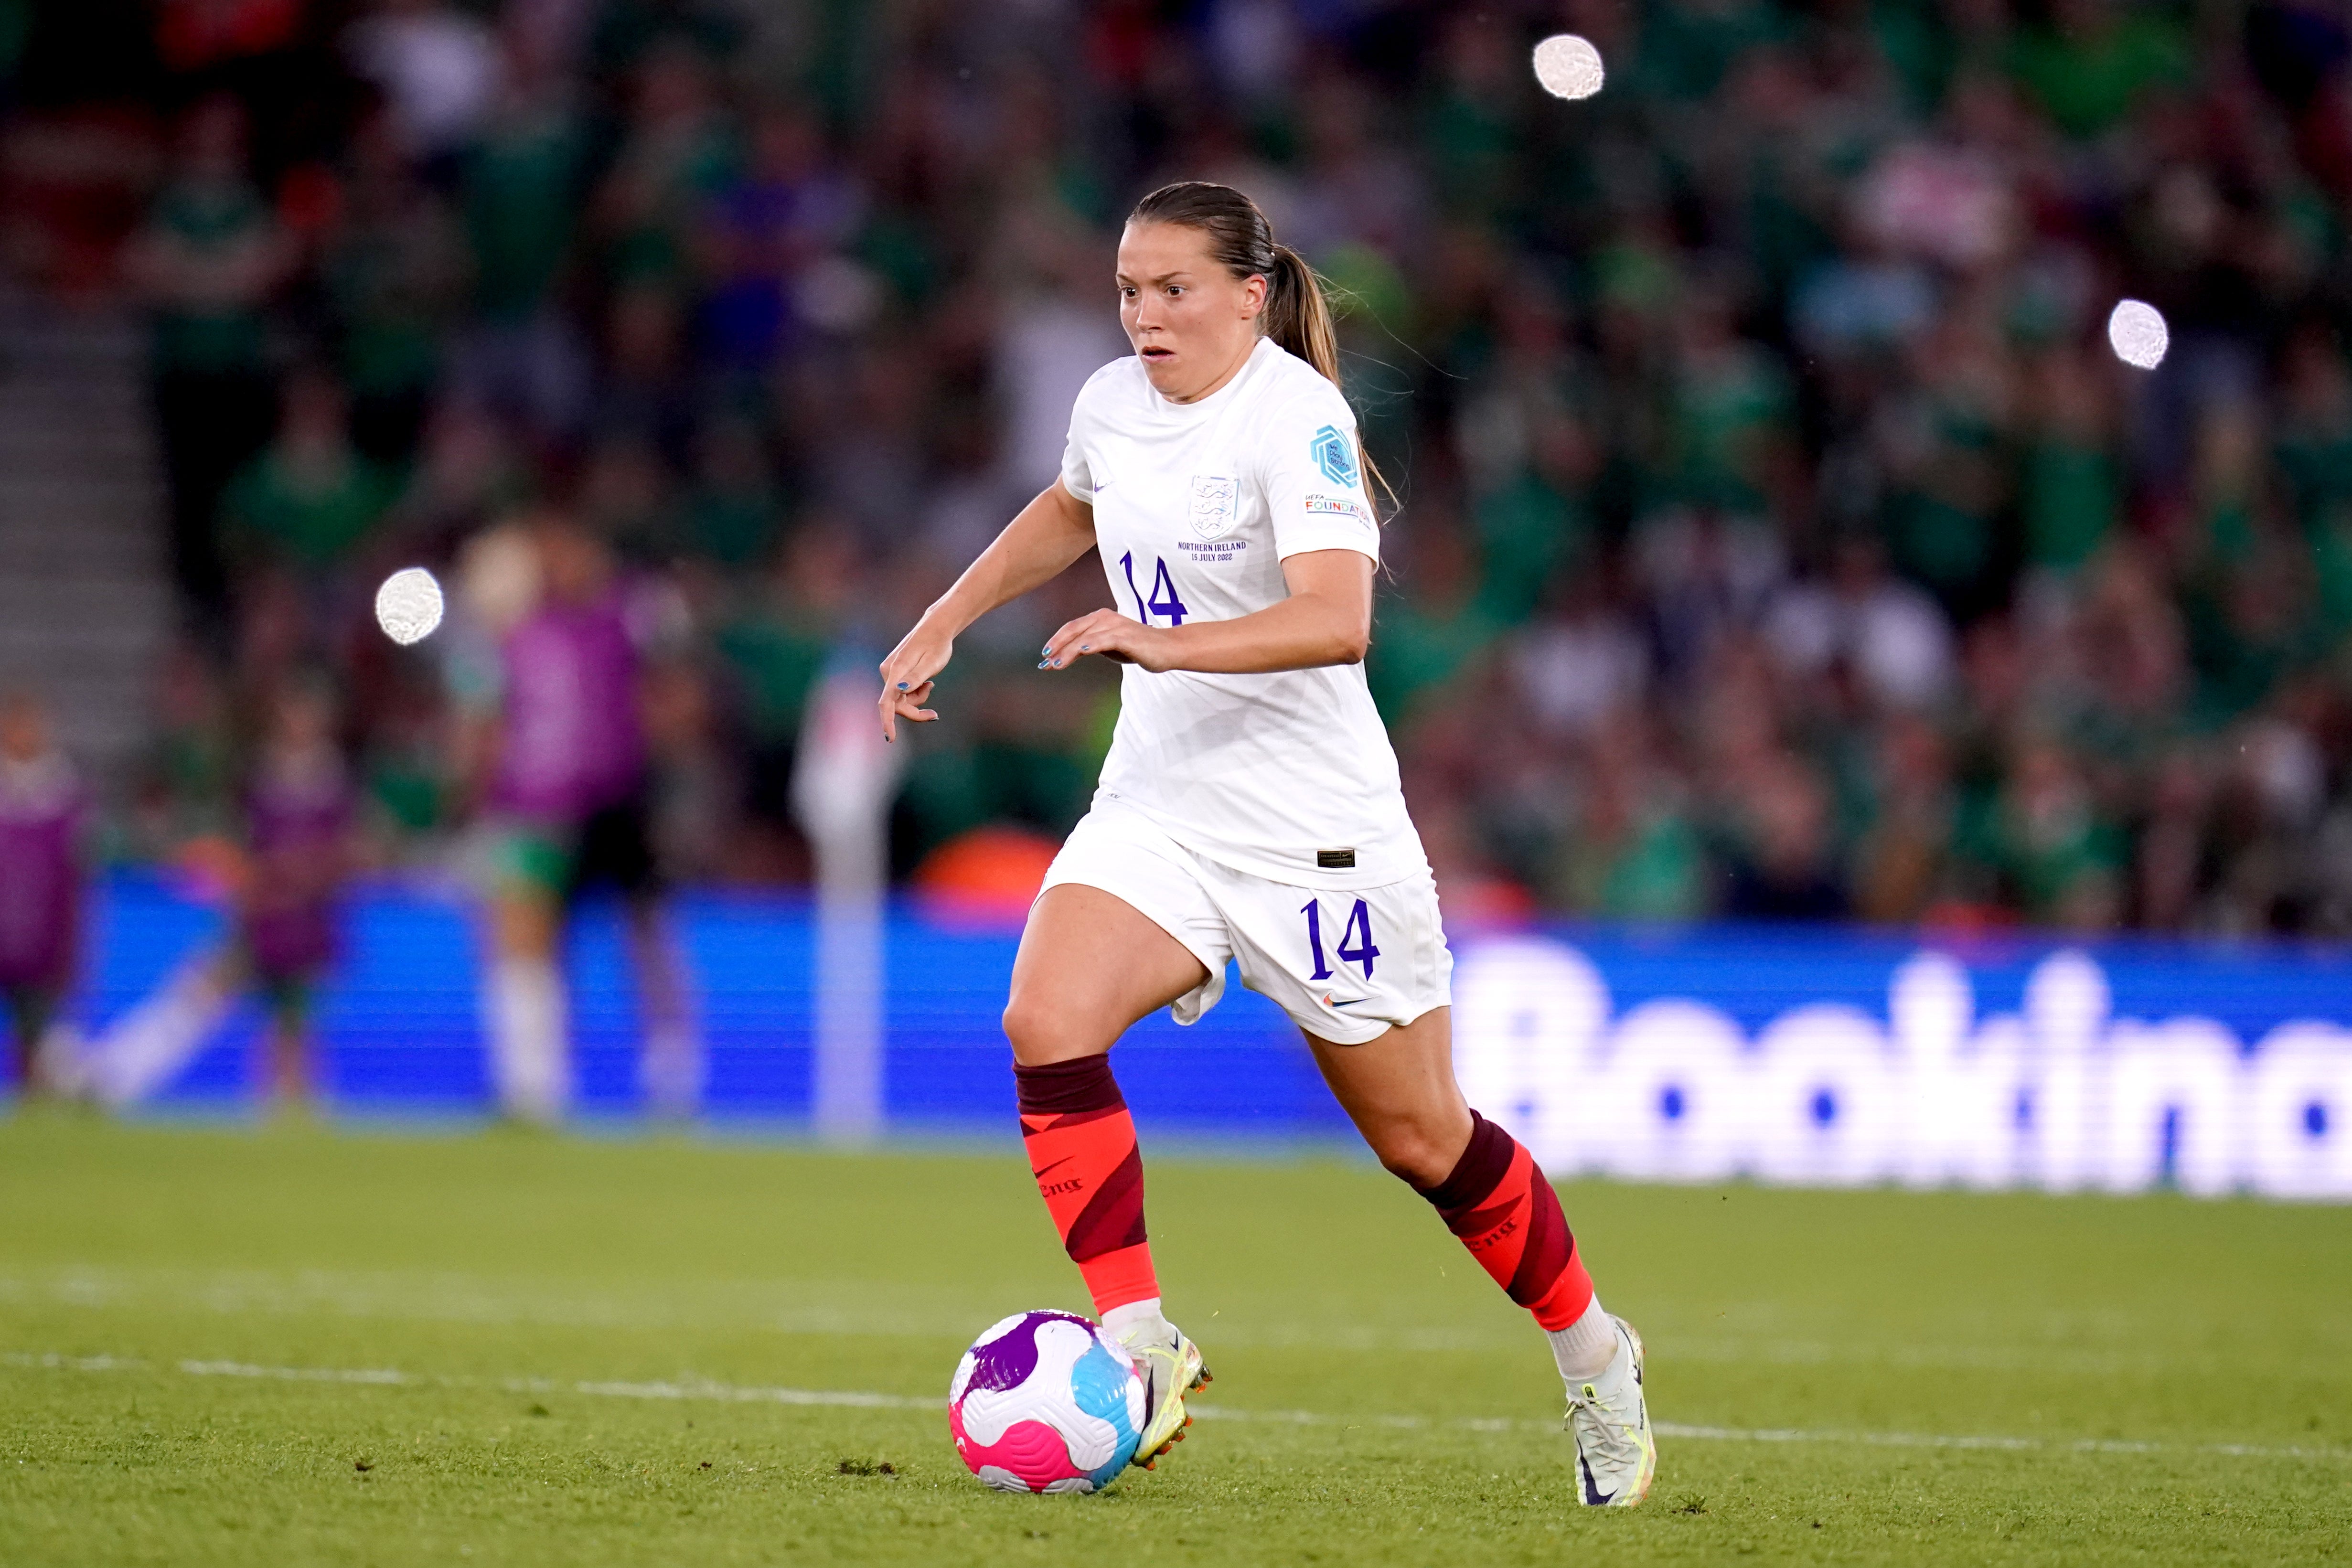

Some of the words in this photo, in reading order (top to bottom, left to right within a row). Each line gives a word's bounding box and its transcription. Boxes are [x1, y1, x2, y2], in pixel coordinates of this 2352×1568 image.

[1306, 501, 1370, 524] FOUNDATION
[1178, 541, 1213, 552] NORTHERN
[1215, 541, 1246, 552] IRELAND
[1218, 553, 1233, 561] 2022
[1120, 550, 1188, 627] 14
[1300, 898, 1380, 982] 14
